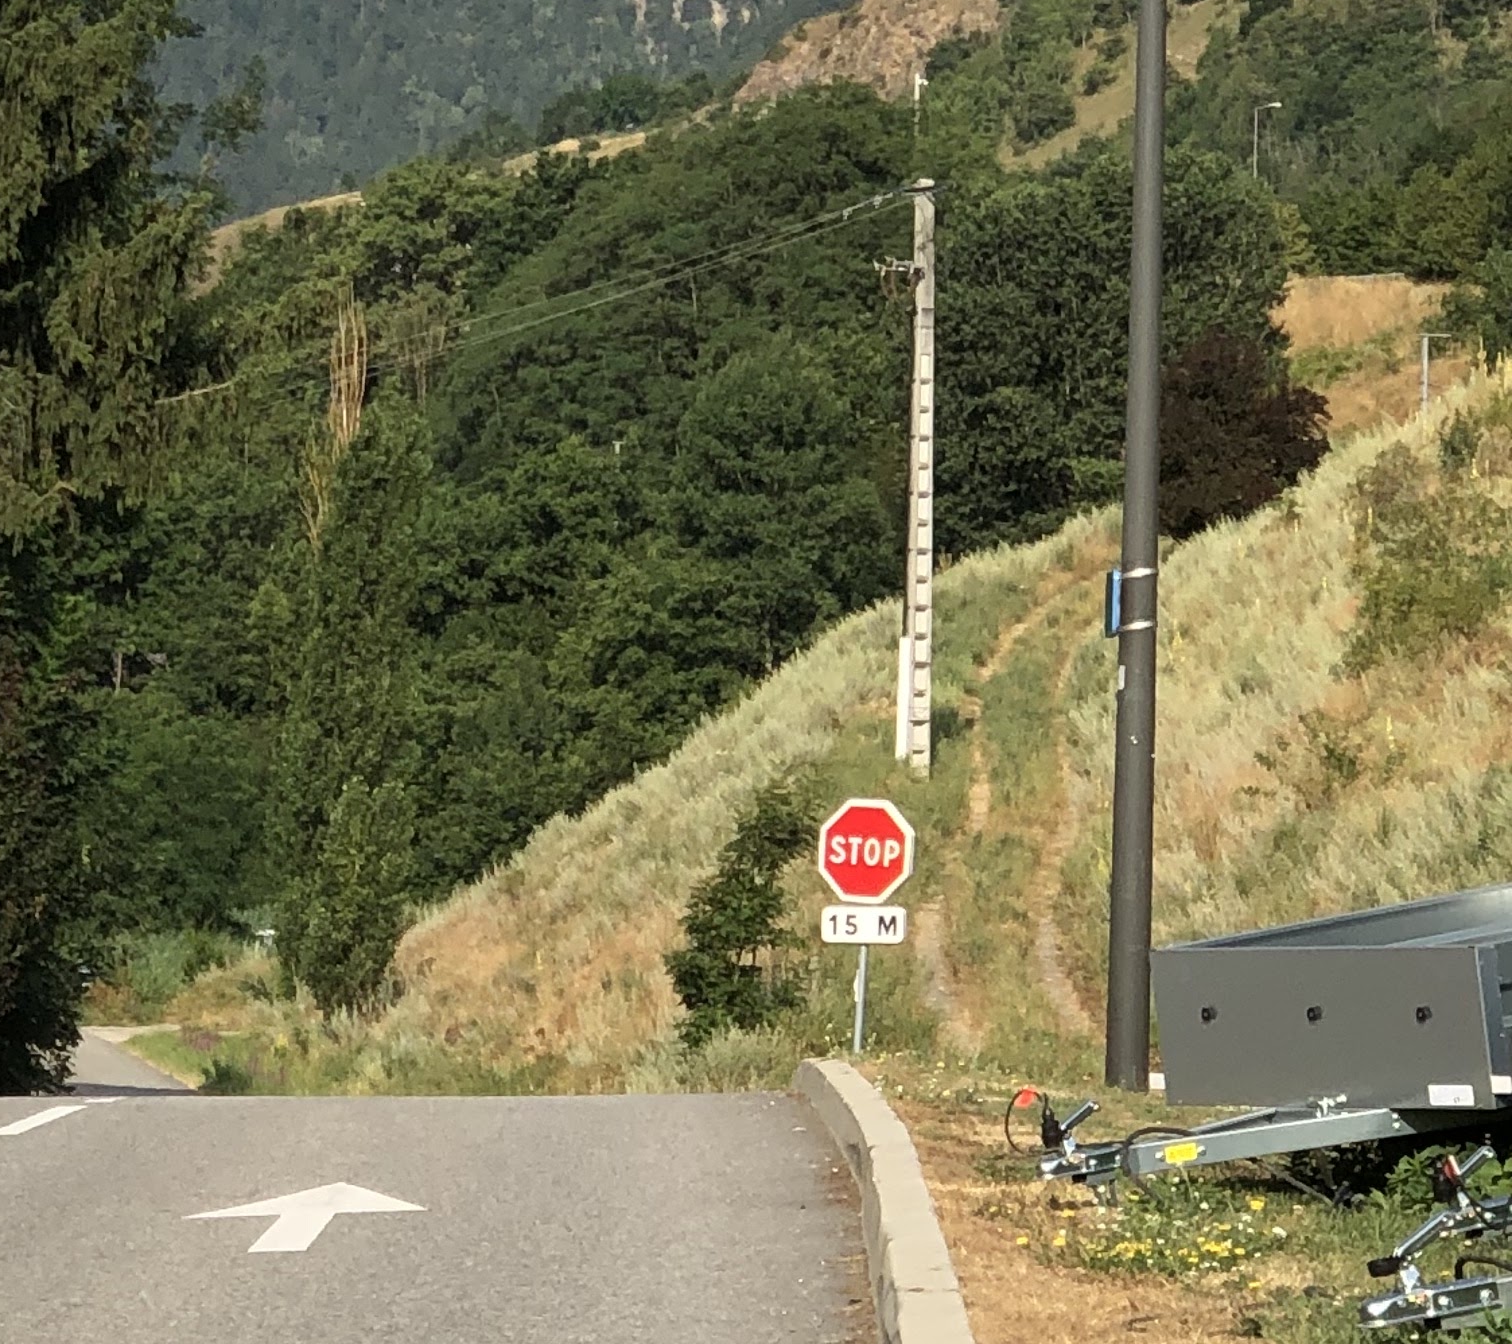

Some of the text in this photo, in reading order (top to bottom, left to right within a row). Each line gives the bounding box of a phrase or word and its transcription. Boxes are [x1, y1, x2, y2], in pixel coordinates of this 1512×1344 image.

[828, 834, 901, 868] STOP
[828, 913, 898, 937] 15 M
